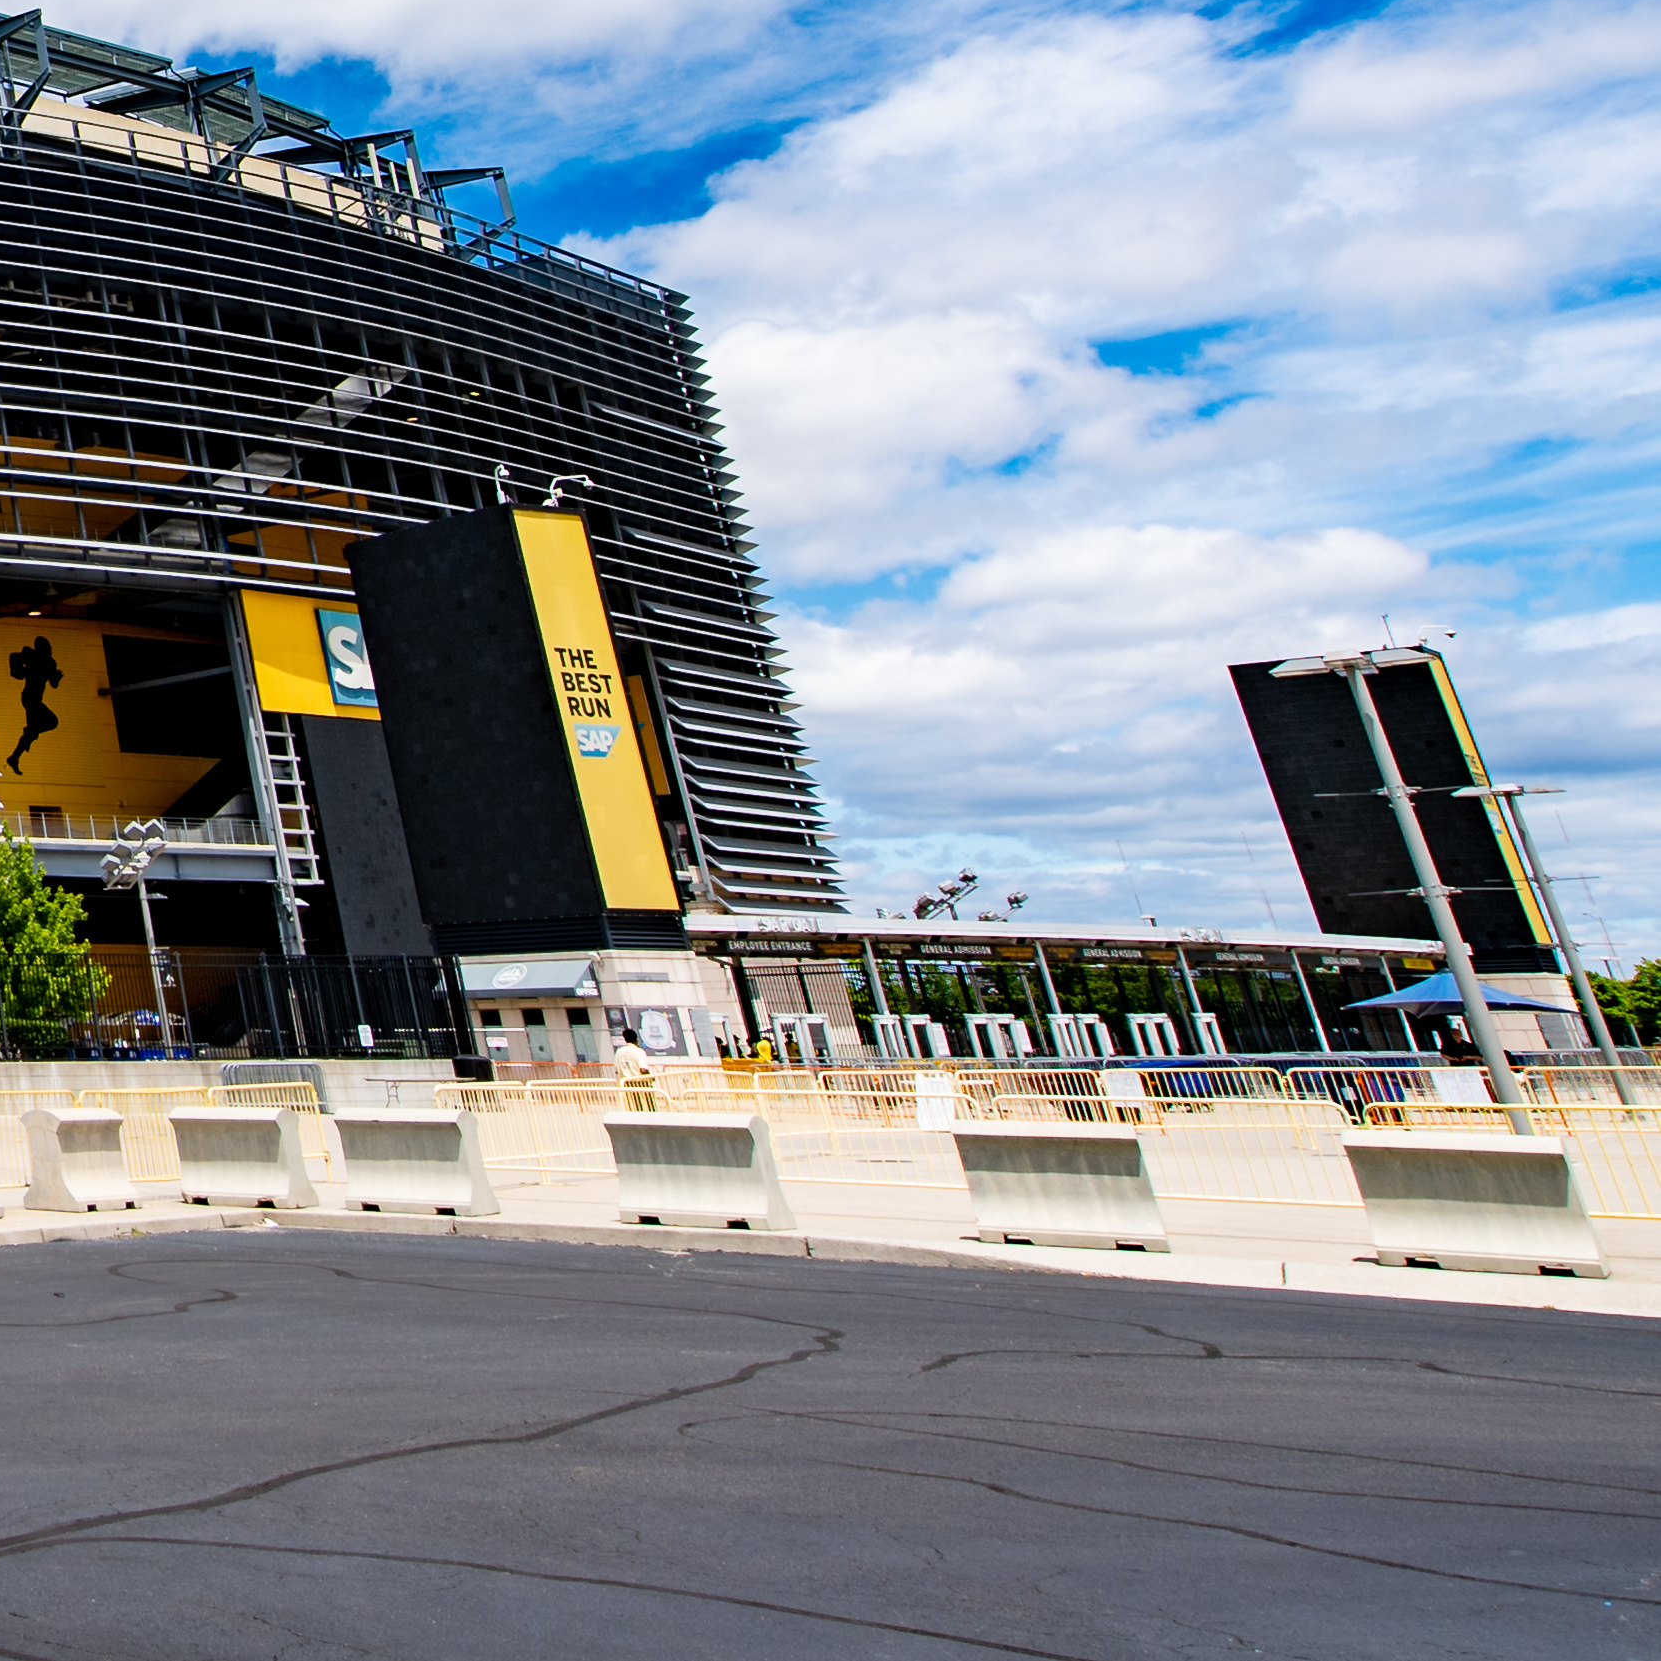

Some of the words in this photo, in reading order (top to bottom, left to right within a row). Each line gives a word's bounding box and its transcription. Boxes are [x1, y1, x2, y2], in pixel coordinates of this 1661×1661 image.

[553, 647, 597, 669] THE
[561, 671, 612, 694] BEST
[566, 696, 612, 718] RUN
[575, 728, 614, 753] SAP
[729, 941, 769, 951] EMPLOYEE
[771, 942, 813, 952] ENTRANCE
